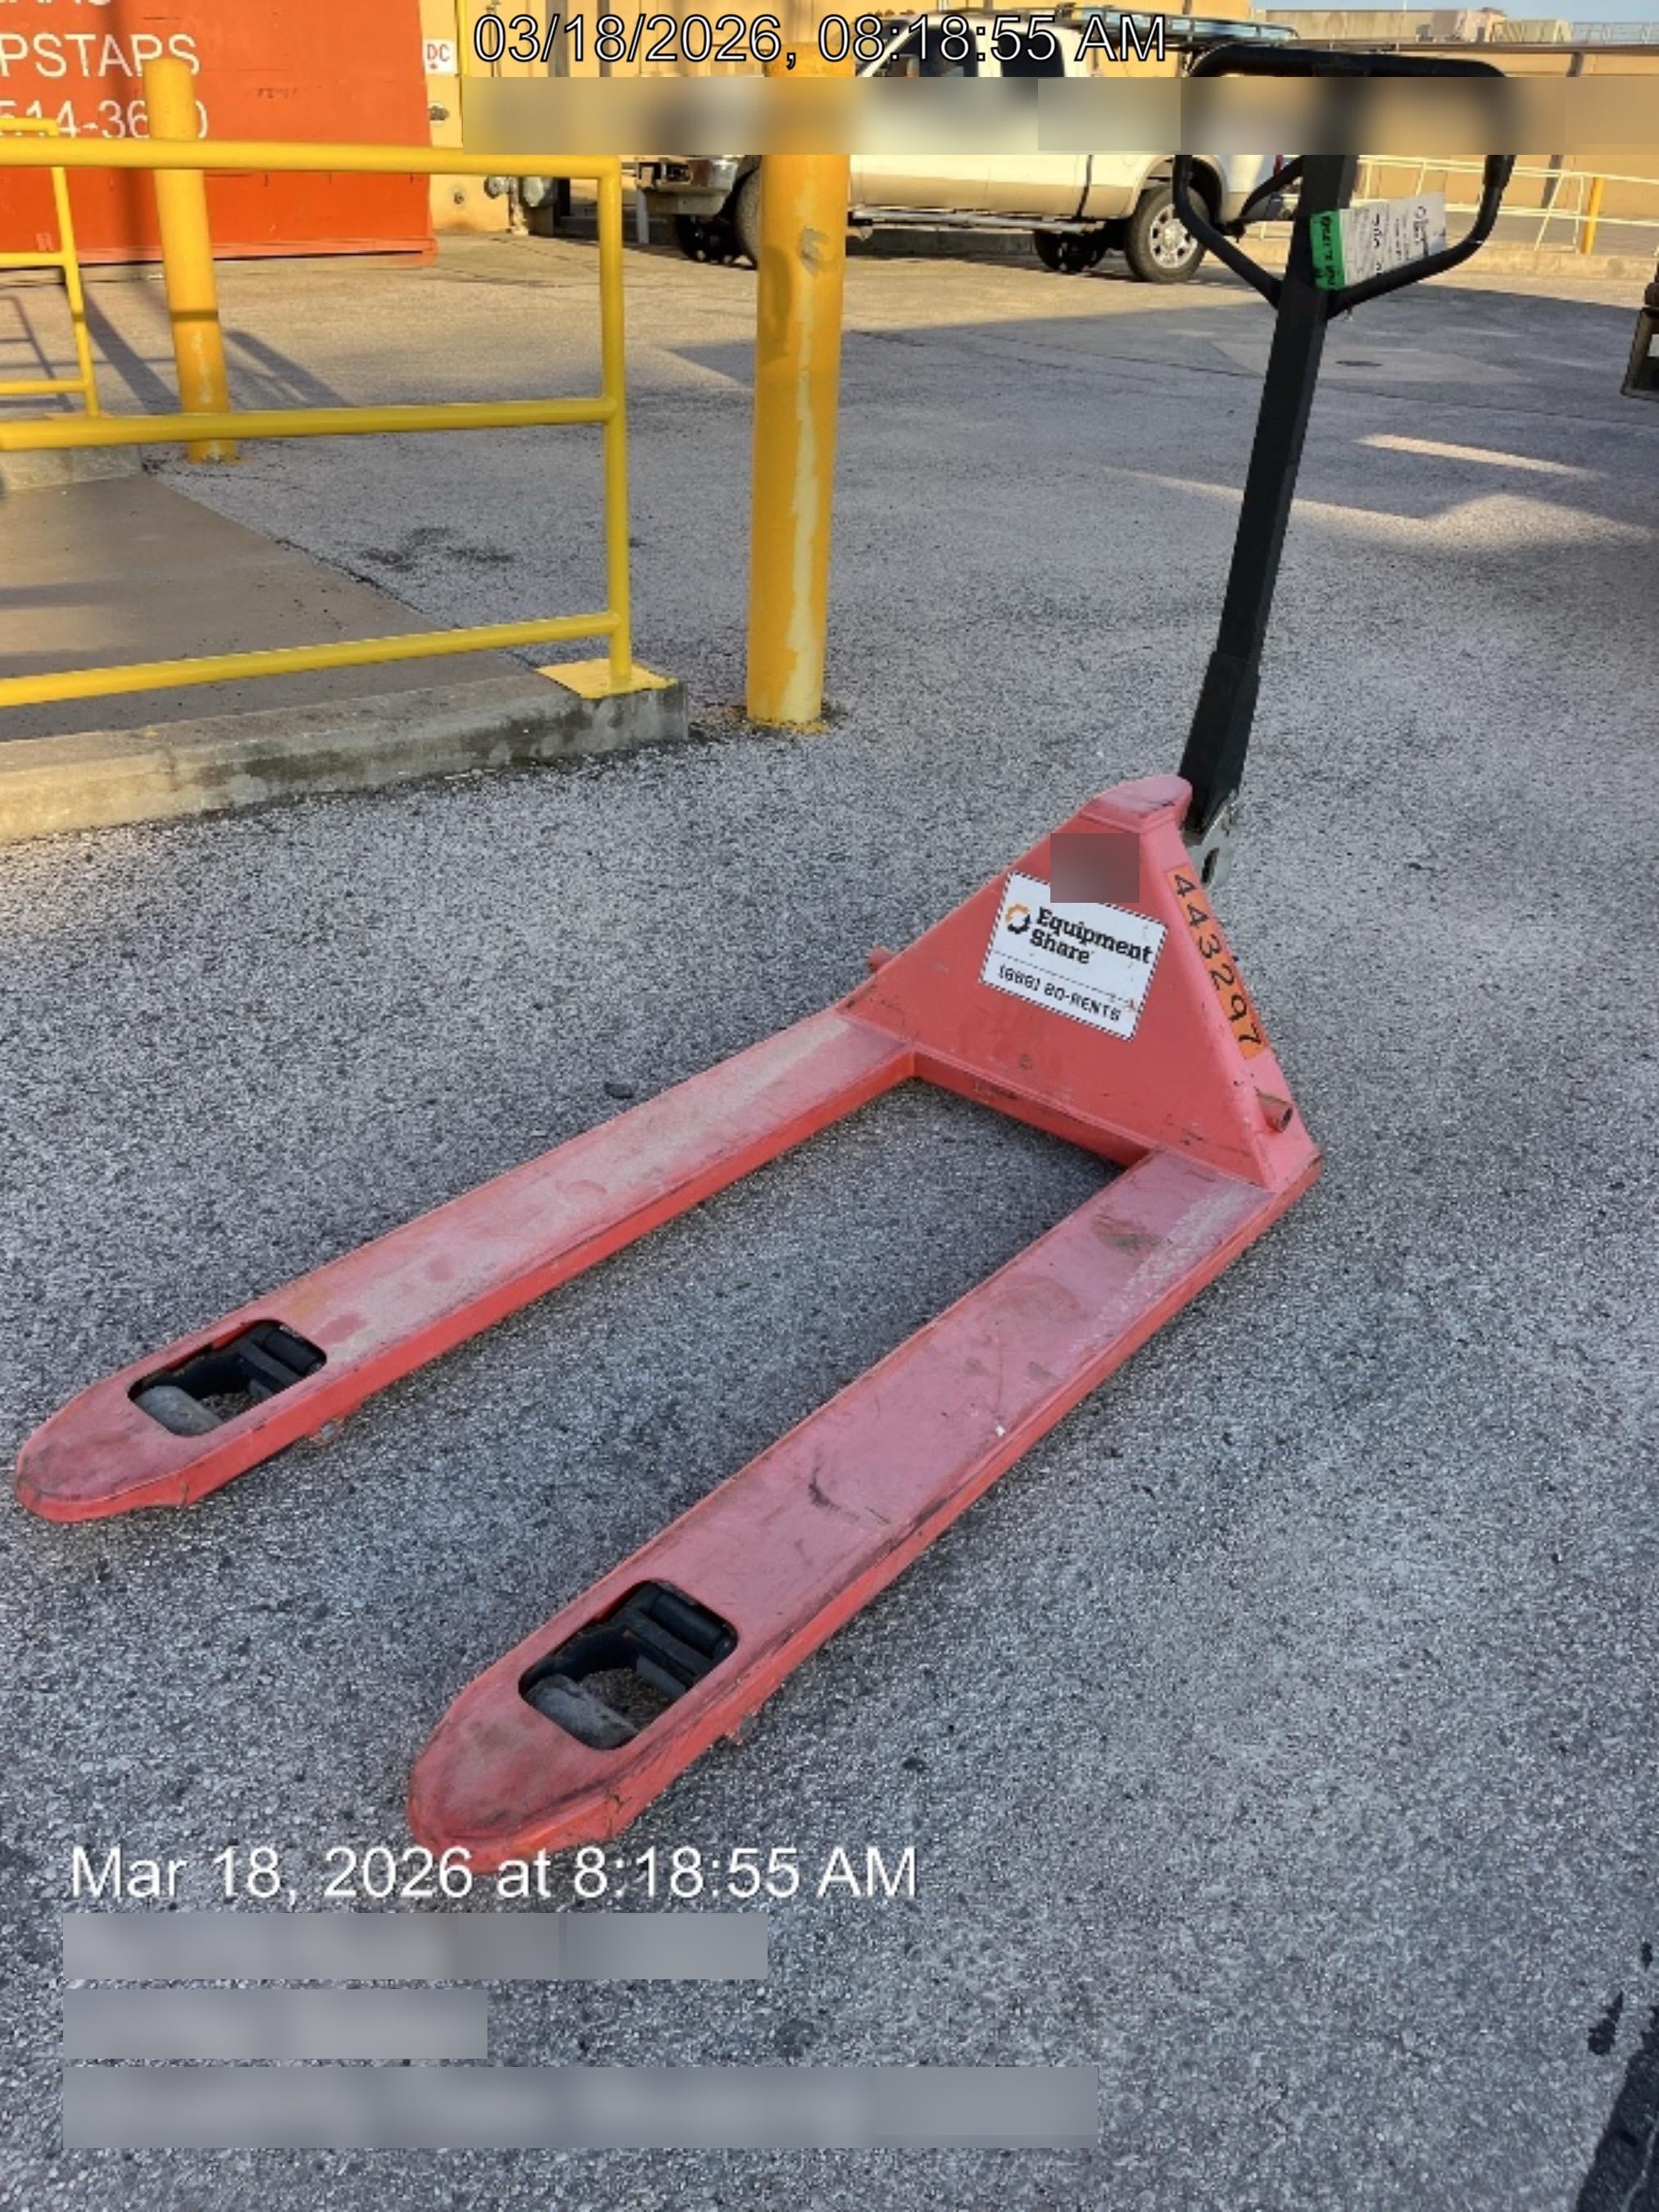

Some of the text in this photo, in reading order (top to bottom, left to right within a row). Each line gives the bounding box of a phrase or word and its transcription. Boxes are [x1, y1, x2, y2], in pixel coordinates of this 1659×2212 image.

[427, 43, 450, 62] DC
[1028, 927, 1091, 965] Share
[1034, 905, 1154, 964] Equipment
[1173, 873, 1262, 1046] 443297
